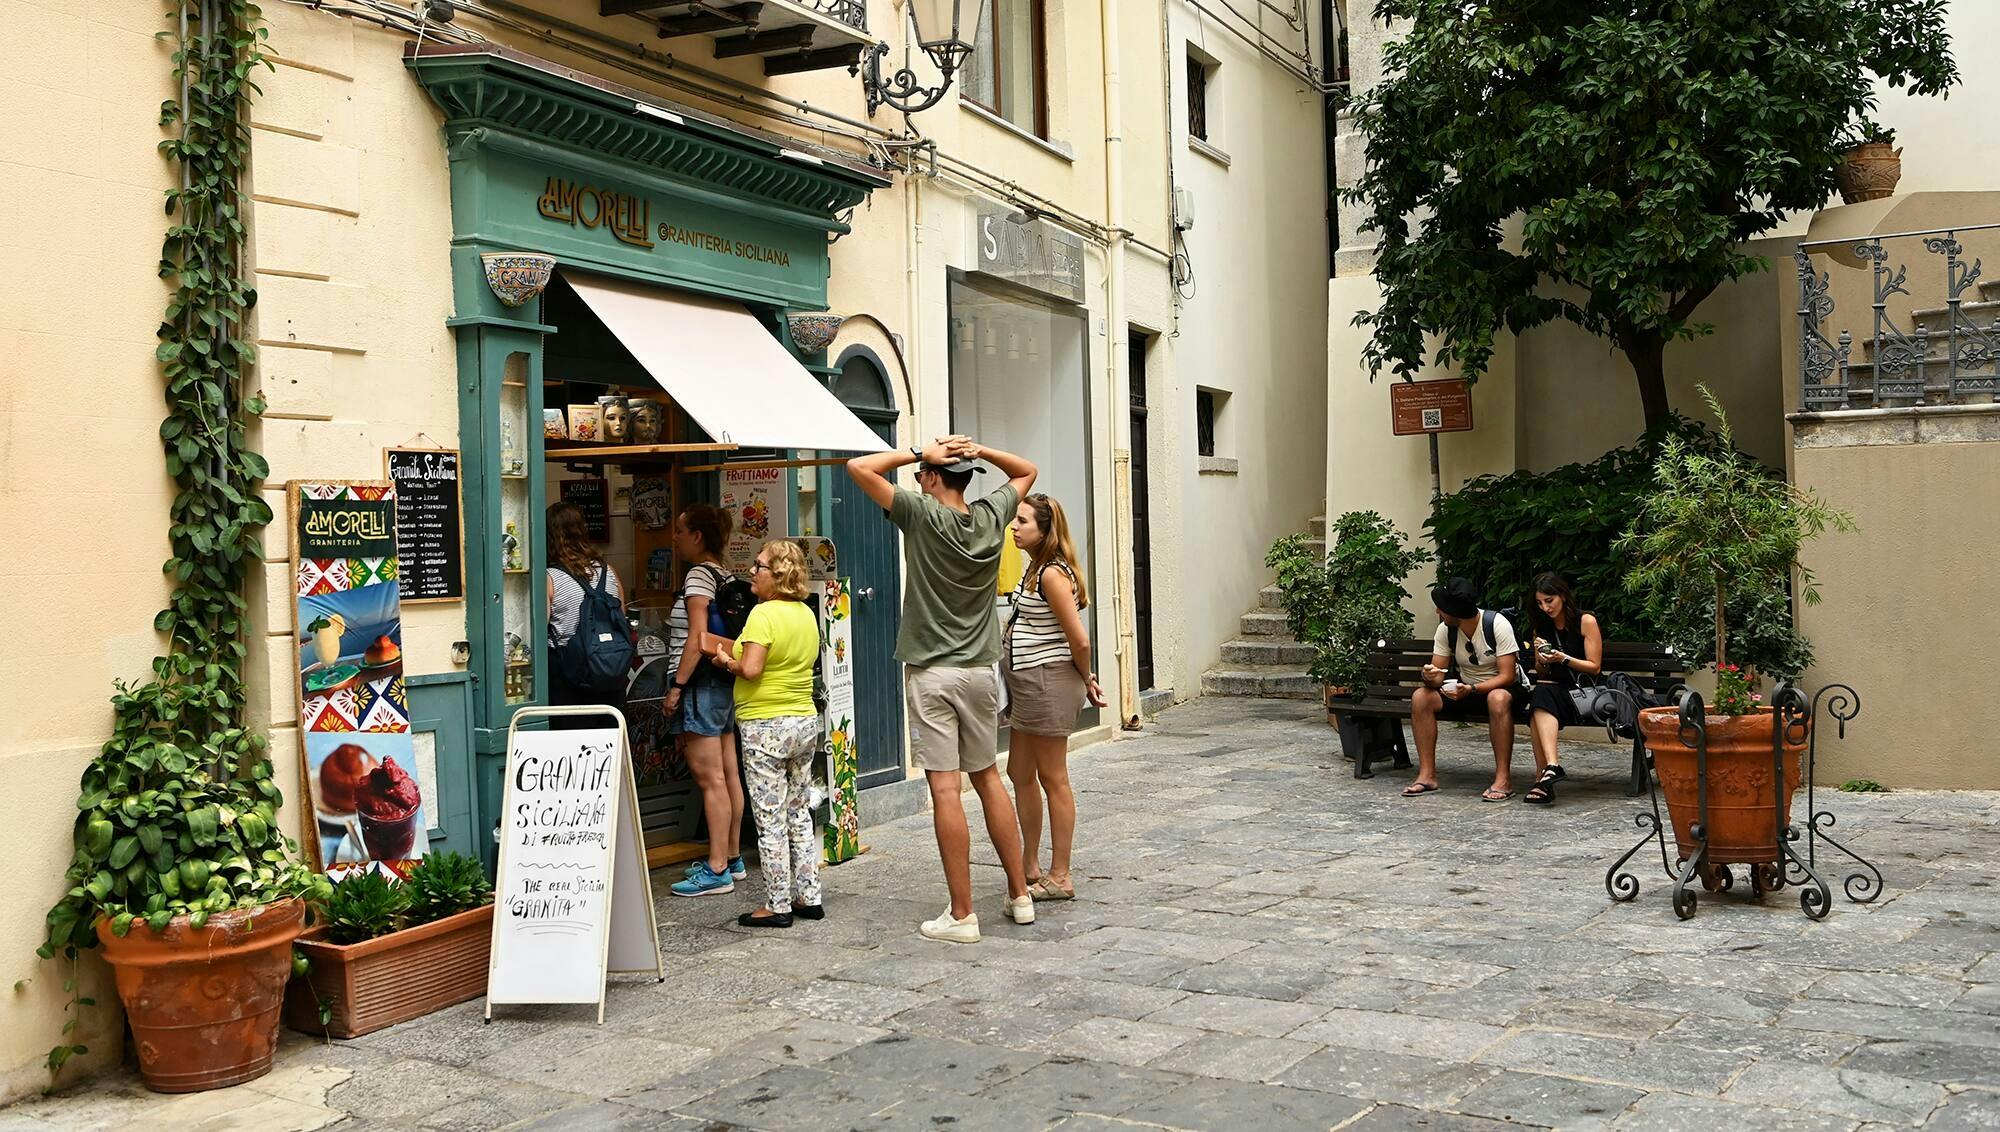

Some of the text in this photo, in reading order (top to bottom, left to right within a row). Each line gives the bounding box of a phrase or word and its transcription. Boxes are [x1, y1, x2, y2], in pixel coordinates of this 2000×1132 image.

[537, 176, 655, 250] AMORELLI
[658, 222, 790, 268] GRANITERIA SICILIANA
[305, 510, 390, 540] AMORELLI
